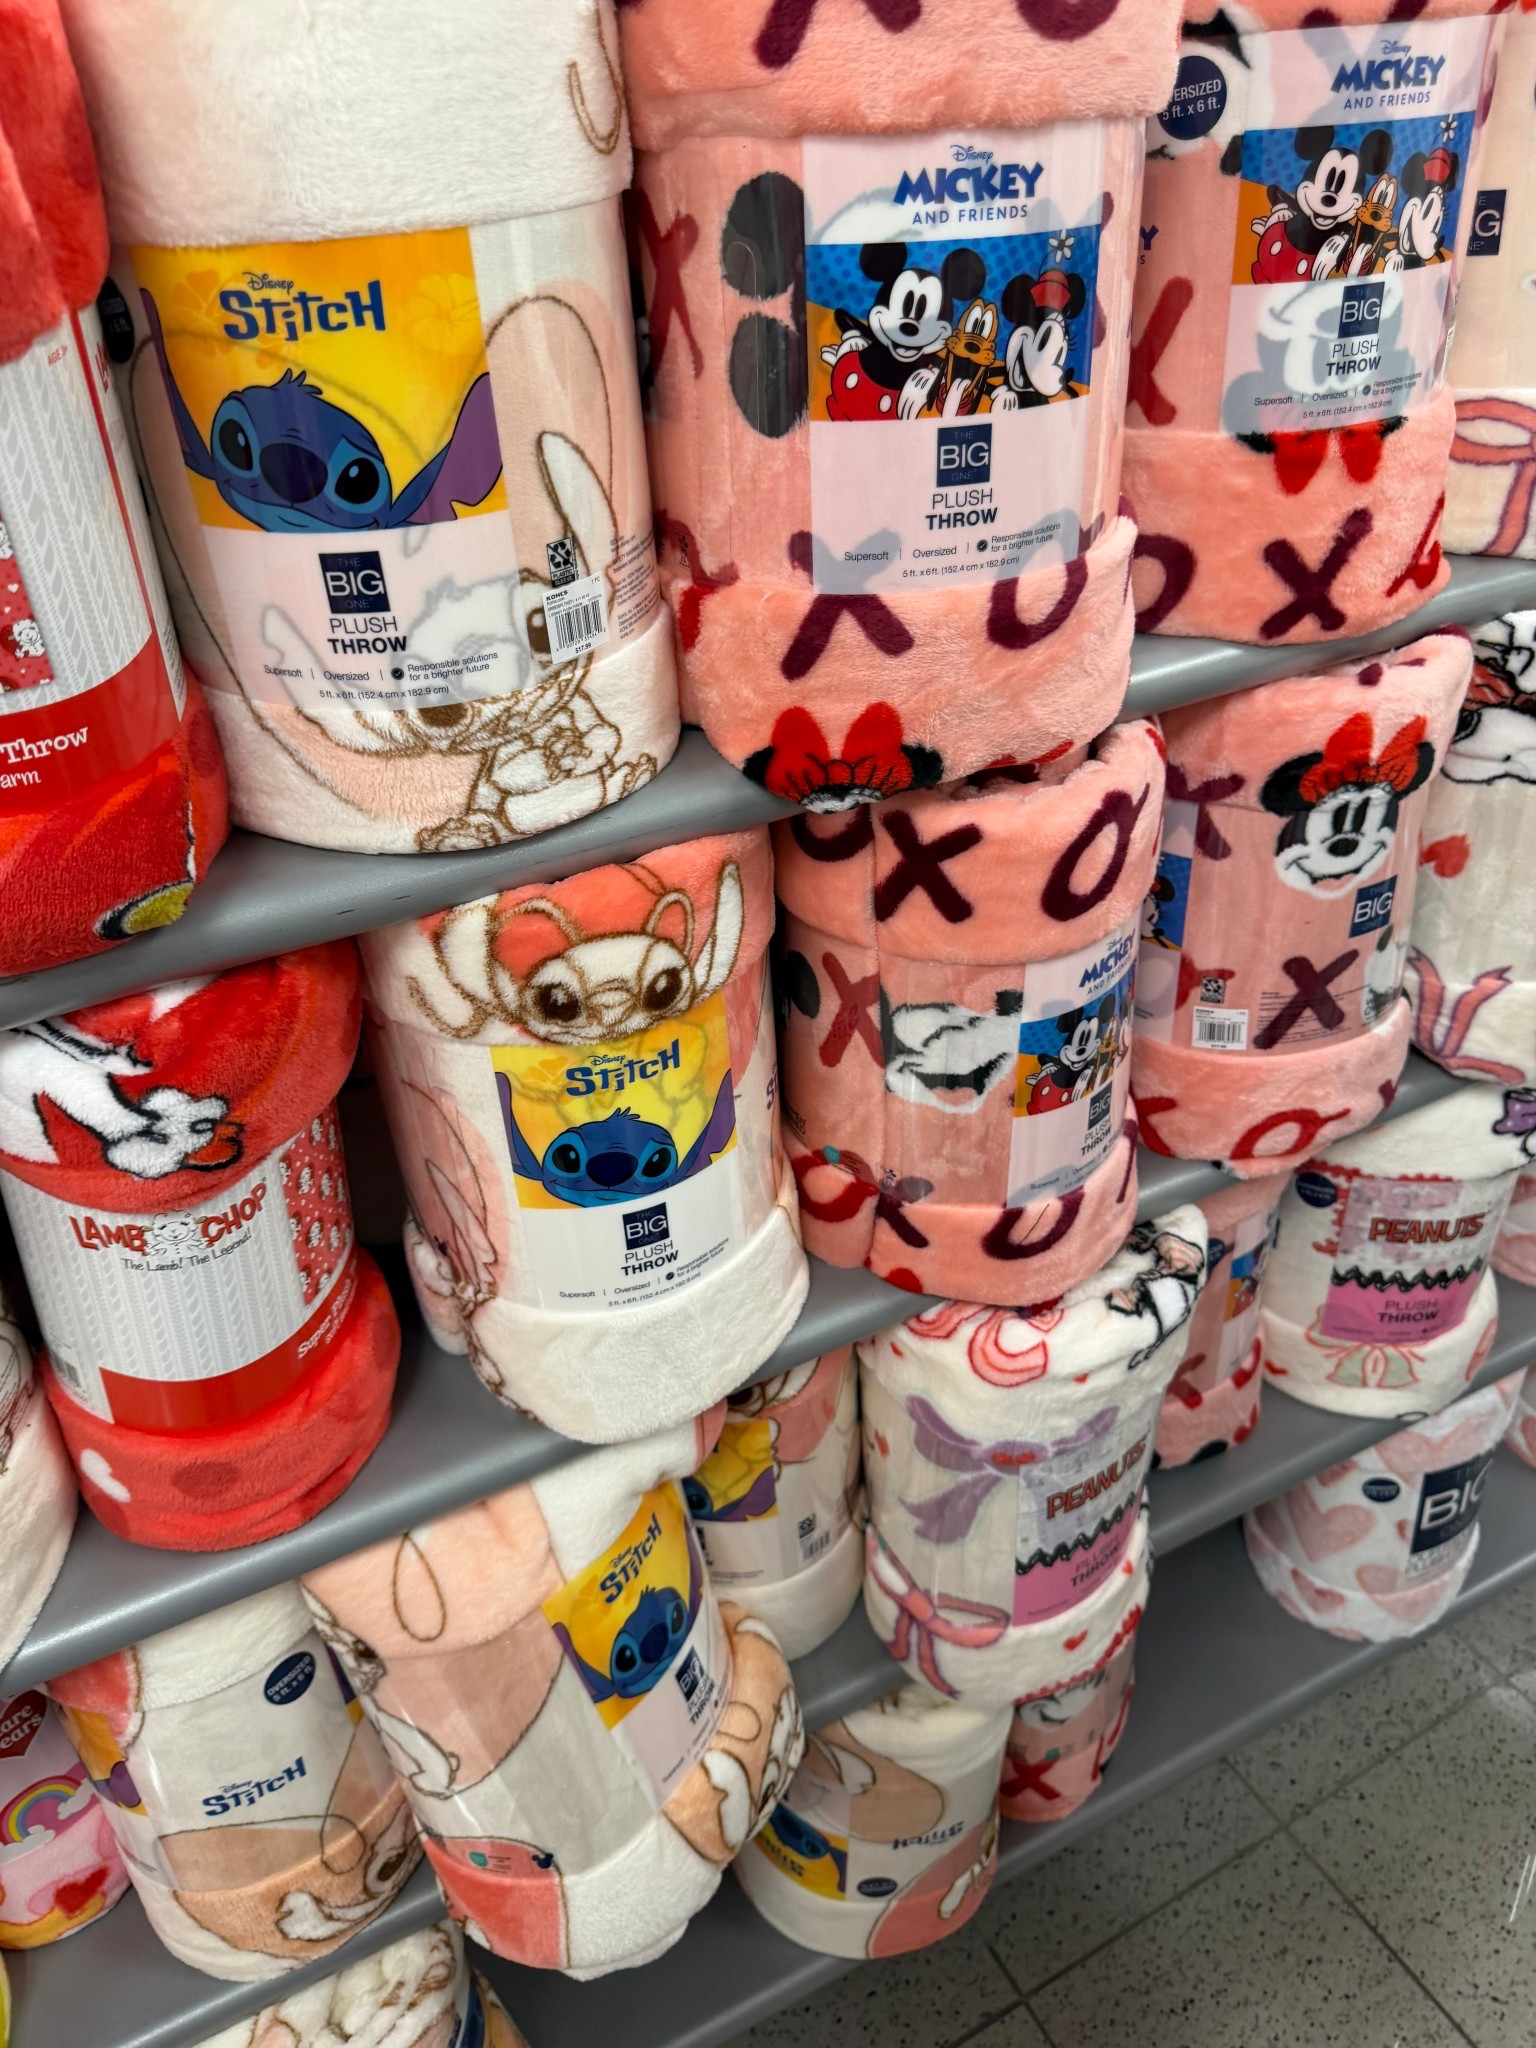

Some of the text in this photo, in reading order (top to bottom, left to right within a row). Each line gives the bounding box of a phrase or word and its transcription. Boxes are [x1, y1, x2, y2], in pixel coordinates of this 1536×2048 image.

[1331, 55, 1445, 94] MICKEY
[1172, 79, 1222, 102] ERSIZED
[1343, 91, 1431, 111] AND FRIENDS
[1171, 105, 1185, 119] ft.
[1187, 106, 1194, 115] x
[1196, 100, 1205, 113] 6
[1206, 97, 1220, 111] ft.
[892, 161, 1044, 205] MICKEY
[912, 204, 1028, 225] AND FRIENDS
[1341, 298, 1381, 323] BIG
[1332, 338, 1379, 359] PLUSH
[1326, 356, 1381, 377] THROW
[1254, 390, 1348, 406] Supersoft Oversized
[939, 442, 989, 470] BIG
[932, 488, 993, 510] PLUSH
[925, 508, 998, 530] THROW
[991, 522, 1061, 546] Responsible solutions
[991, 544, 1001, 553] for
[1008, 537, 1035, 550] brighter
[1035, 533, 1053, 544] future
[844, 546, 957, 562] Supersoft Oversized
[552, 568, 573, 580] PLASTIC
[941, 565, 965, 575] (152.4
[986, 558, 1006, 569] 182.9
[1006, 556, 1020, 566] cm)
[325, 569, 385, 596] BIG
[330, 616, 398, 634] PLUSH
[327, 635, 407, 655] THROW
[263, 664, 370, 681] Supersoft Oversized
[407, 652, 498, 673] Responsible solutions
[409, 672, 421, 682] for
[431, 666, 464, 680] brighter
[466, 662, 490, 674] future
[357, 690, 384, 700] (152.4
[384, 690, 399, 699] cm
[407, 687, 430, 698] 182.9
[431, 685, 449, 696] cm)
[0, 726, 88, 764] Throw
[0, 770, 42, 789] arm
[1354, 892, 1393, 924] BIG
[1087, 979, 1105, 996] AND
[1090, 1091, 1111, 1120] BIG
[1081, 1126, 1112, 1156] THROW
[1084, 1117, 1111, 1144] PLUSH
[69, 1182, 267, 1256] LAMB CHOP
[625, 1214, 667, 1240] BIG
[1369, 1212, 1487, 1243] PEANUTS
[122, 1228, 253, 1272] The Lamb! The Legend!
[624, 1239, 674, 1264] PLUSH
[621, 1250, 679, 1276] THROW
[676, 1252, 708, 1273] Responsible
[559, 1281, 651, 1298] Supersoft Oversized
[1378, 1311, 1440, 1323] THROW
[1384, 1300, 1438, 1312] PLUSH
[1047, 1433, 1147, 1520] PEANUTS
[266, 1655, 312, 1697] OVERSIZED
[0, 1705, 32, 1733] are
[0, 1713, 41, 1749] ears
